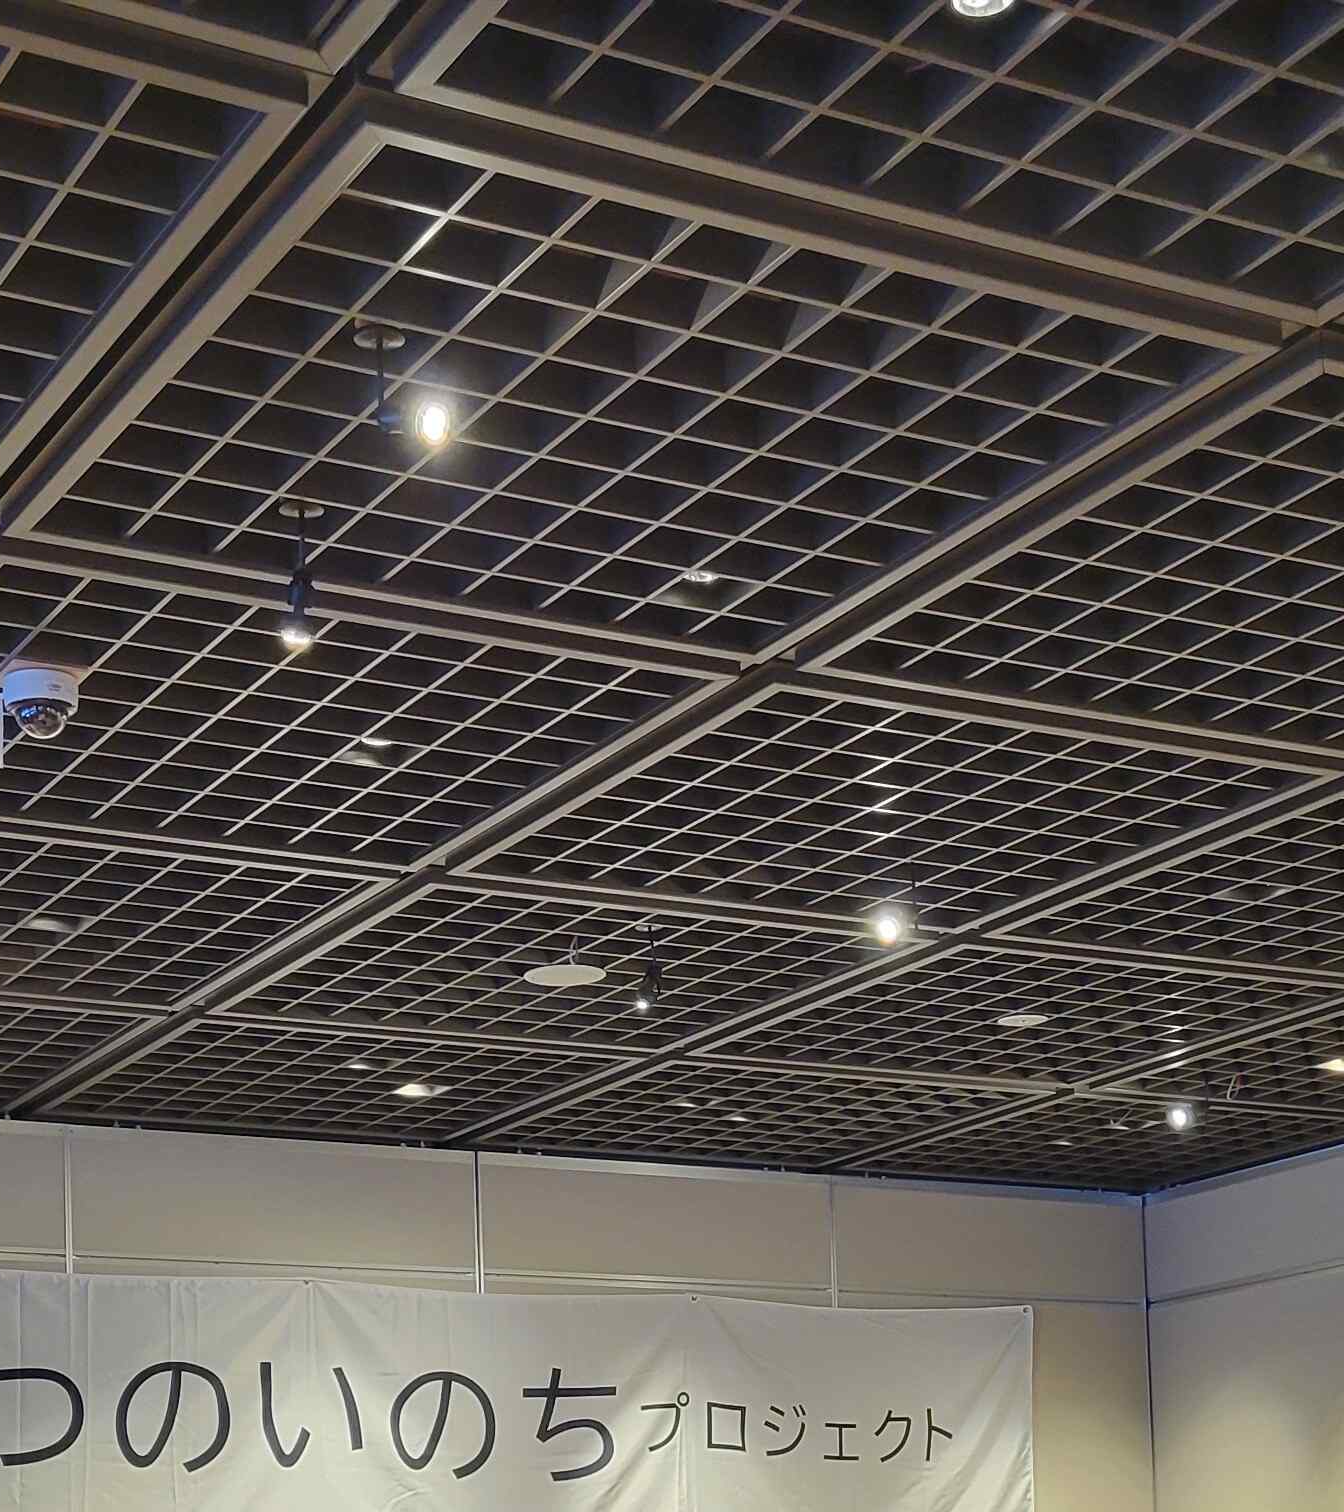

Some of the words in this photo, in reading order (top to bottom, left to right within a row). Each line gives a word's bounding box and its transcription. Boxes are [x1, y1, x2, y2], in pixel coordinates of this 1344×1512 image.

[639, 1390, 955, 1464] プロジェクト
